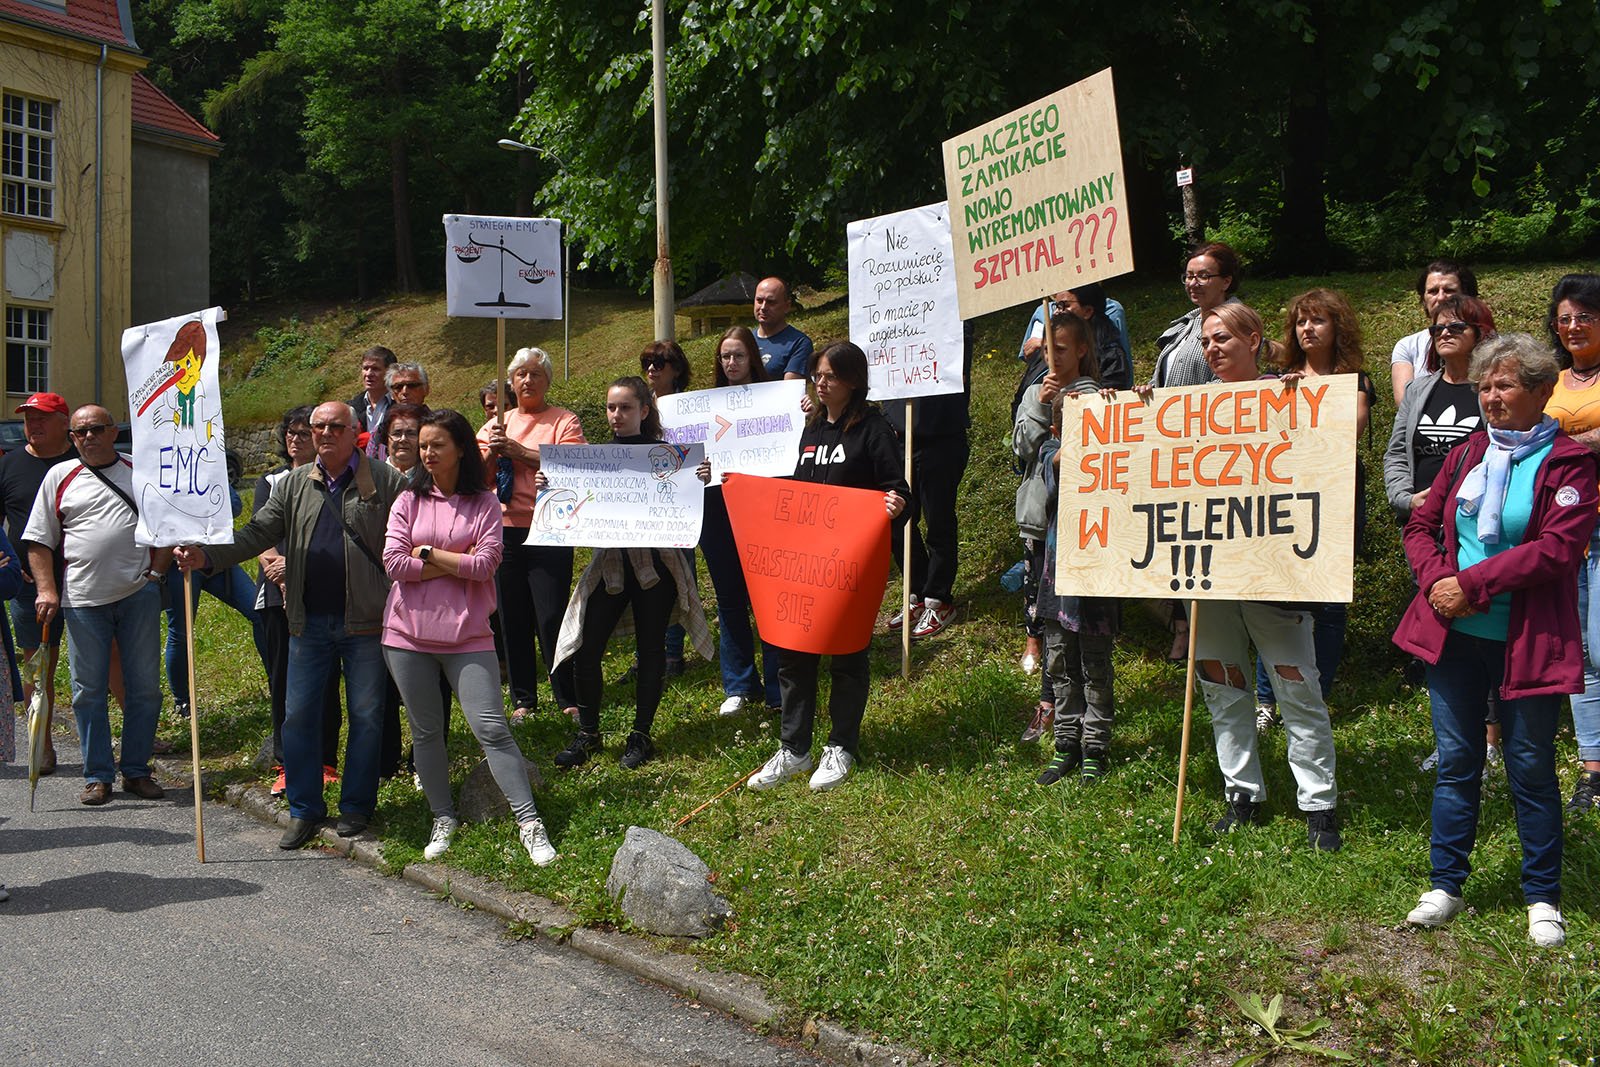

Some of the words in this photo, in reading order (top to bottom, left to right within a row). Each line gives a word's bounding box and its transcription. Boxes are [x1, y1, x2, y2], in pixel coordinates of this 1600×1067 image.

[957, 104, 1060, 170] DLACZEGO
[961, 132, 1067, 197] ZAMYKACIE
[470, 220, 512, 231] STRATEGIA
[516, 222, 539, 233] EMC
[964, 188, 1013, 227] NOWO
[968, 172, 1115, 254] WYREMONTOWANY
[886, 227, 909, 252] Nie
[519, 269, 555, 278] EKONOMIA
[862, 248, 944, 276] Rozumiecie
[974, 235, 1064, 290] SZPITAL
[874, 279, 892, 300] po
[894, 265, 942, 296] polsku?
[863, 303, 881, 324] To
[884, 300, 919, 322] macie
[922, 300, 935, 323] po
[867, 347, 896, 367] LEAVE
[904, 345, 918, 362] IT
[920, 342, 936, 361] AS
[887, 369, 900, 387] IT
[677, 395, 711, 415] DROGIE
[727, 388, 753, 411] EMC
[1082, 401, 1144, 447] NIE
[1157, 384, 1329, 438] CHCEMY
[736, 413, 793, 438] EKONOMIA
[160, 444, 210, 496] EMC
[547, 463, 575, 473] CHCEMY
[801, 444, 846, 466] FILA
[1078, 450, 1130, 494] SIĘ
[1151, 430, 1293, 488] LECZYĆ
[774, 489, 839, 529] EMC
[1079, 506, 1110, 550] W
[1130, 491, 1320, 570] JELENIEJ
[747, 543, 858, 592] ZASTANÓW
[1170, 544, 1213, 592] !!!
[776, 591, 814, 632] SIĘ
